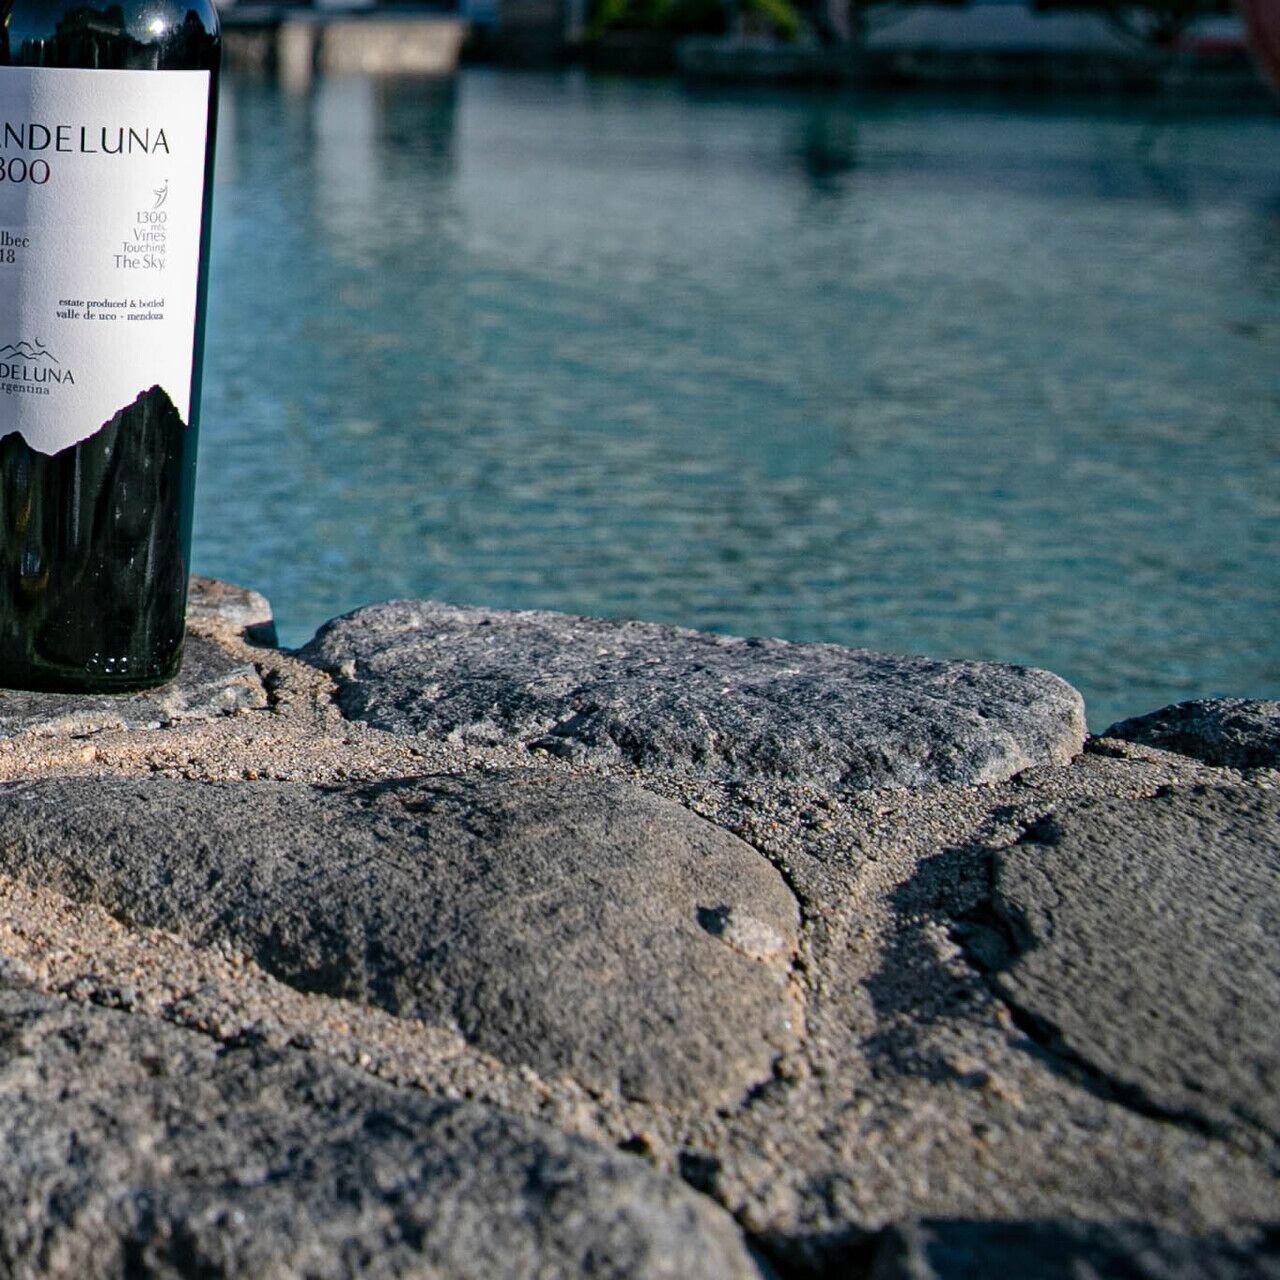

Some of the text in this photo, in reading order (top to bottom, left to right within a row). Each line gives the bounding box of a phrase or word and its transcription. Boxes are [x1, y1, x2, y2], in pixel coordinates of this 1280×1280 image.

[137, 210, 167, 224] 1300
[133, 228, 166, 241] Vines
[122, 241, 166, 255] Touching
[112, 254, 140, 269] The
[58, 299, 165, 310] estate produced & bottled
[56, 309, 81, 320] valle
[83, 310, 96, 320] de
[98, 312, 117, 321] uco
[127, 311, 164, 321] mendoza
